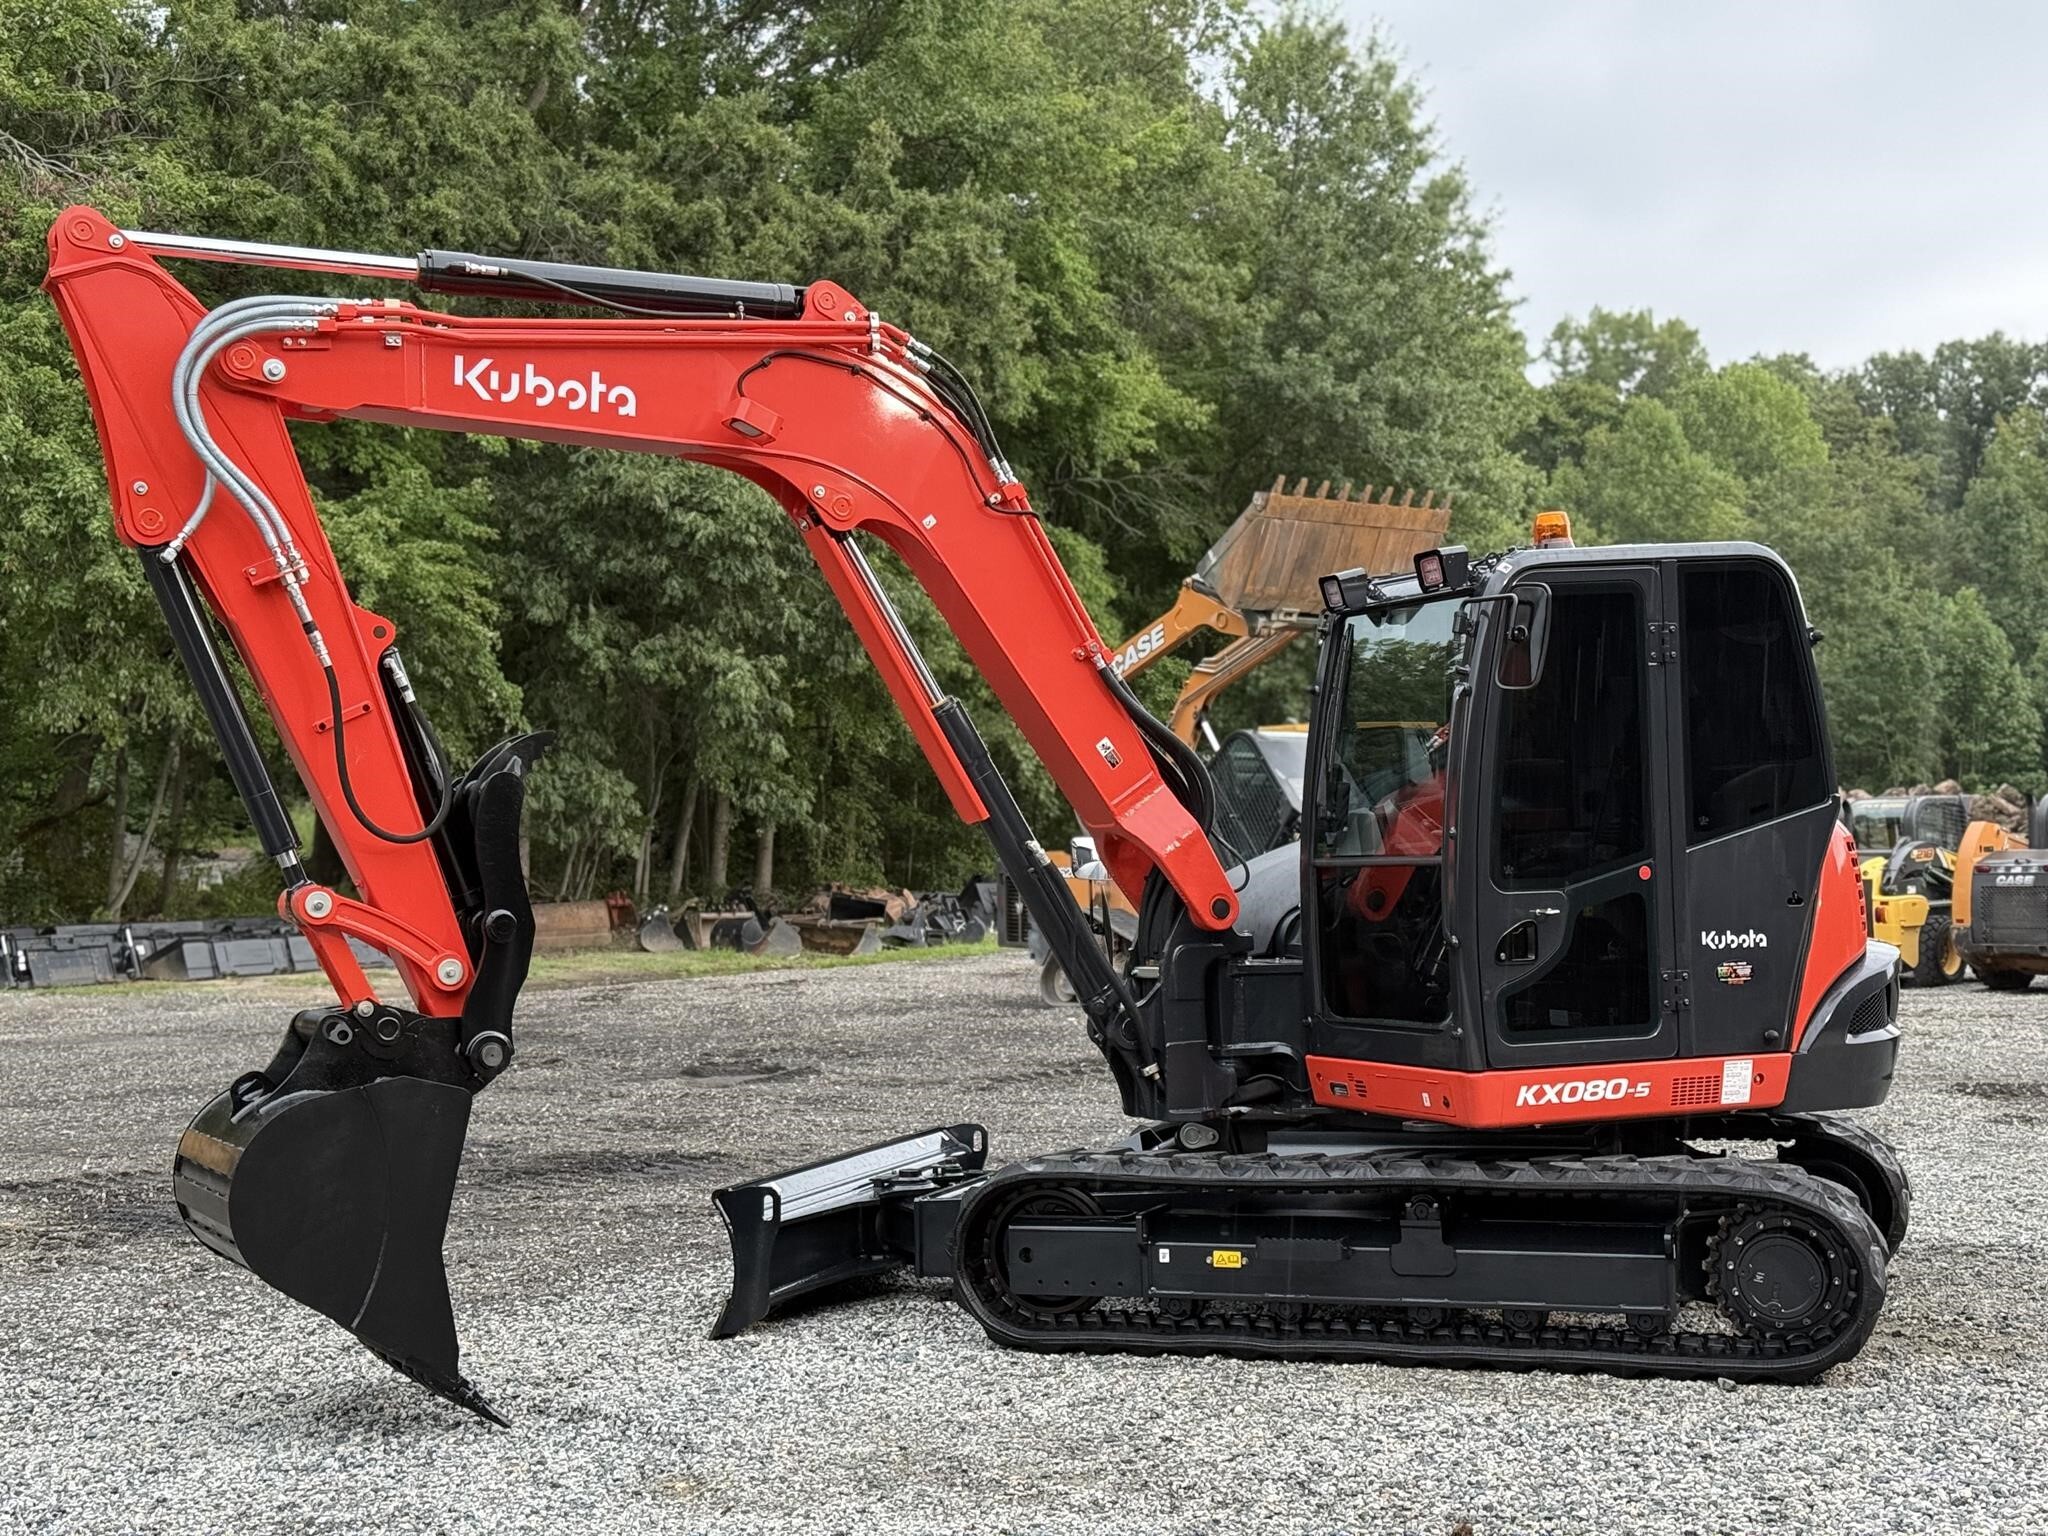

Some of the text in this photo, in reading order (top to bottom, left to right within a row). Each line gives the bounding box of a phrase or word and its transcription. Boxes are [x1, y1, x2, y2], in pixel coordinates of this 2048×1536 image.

[453, 354, 637, 417] Kubota
[1996, 874, 2036, 887] CASE
[1701, 928, 1768, 950] Kubota
[1516, 1078, 1652, 1107] KX080-5
